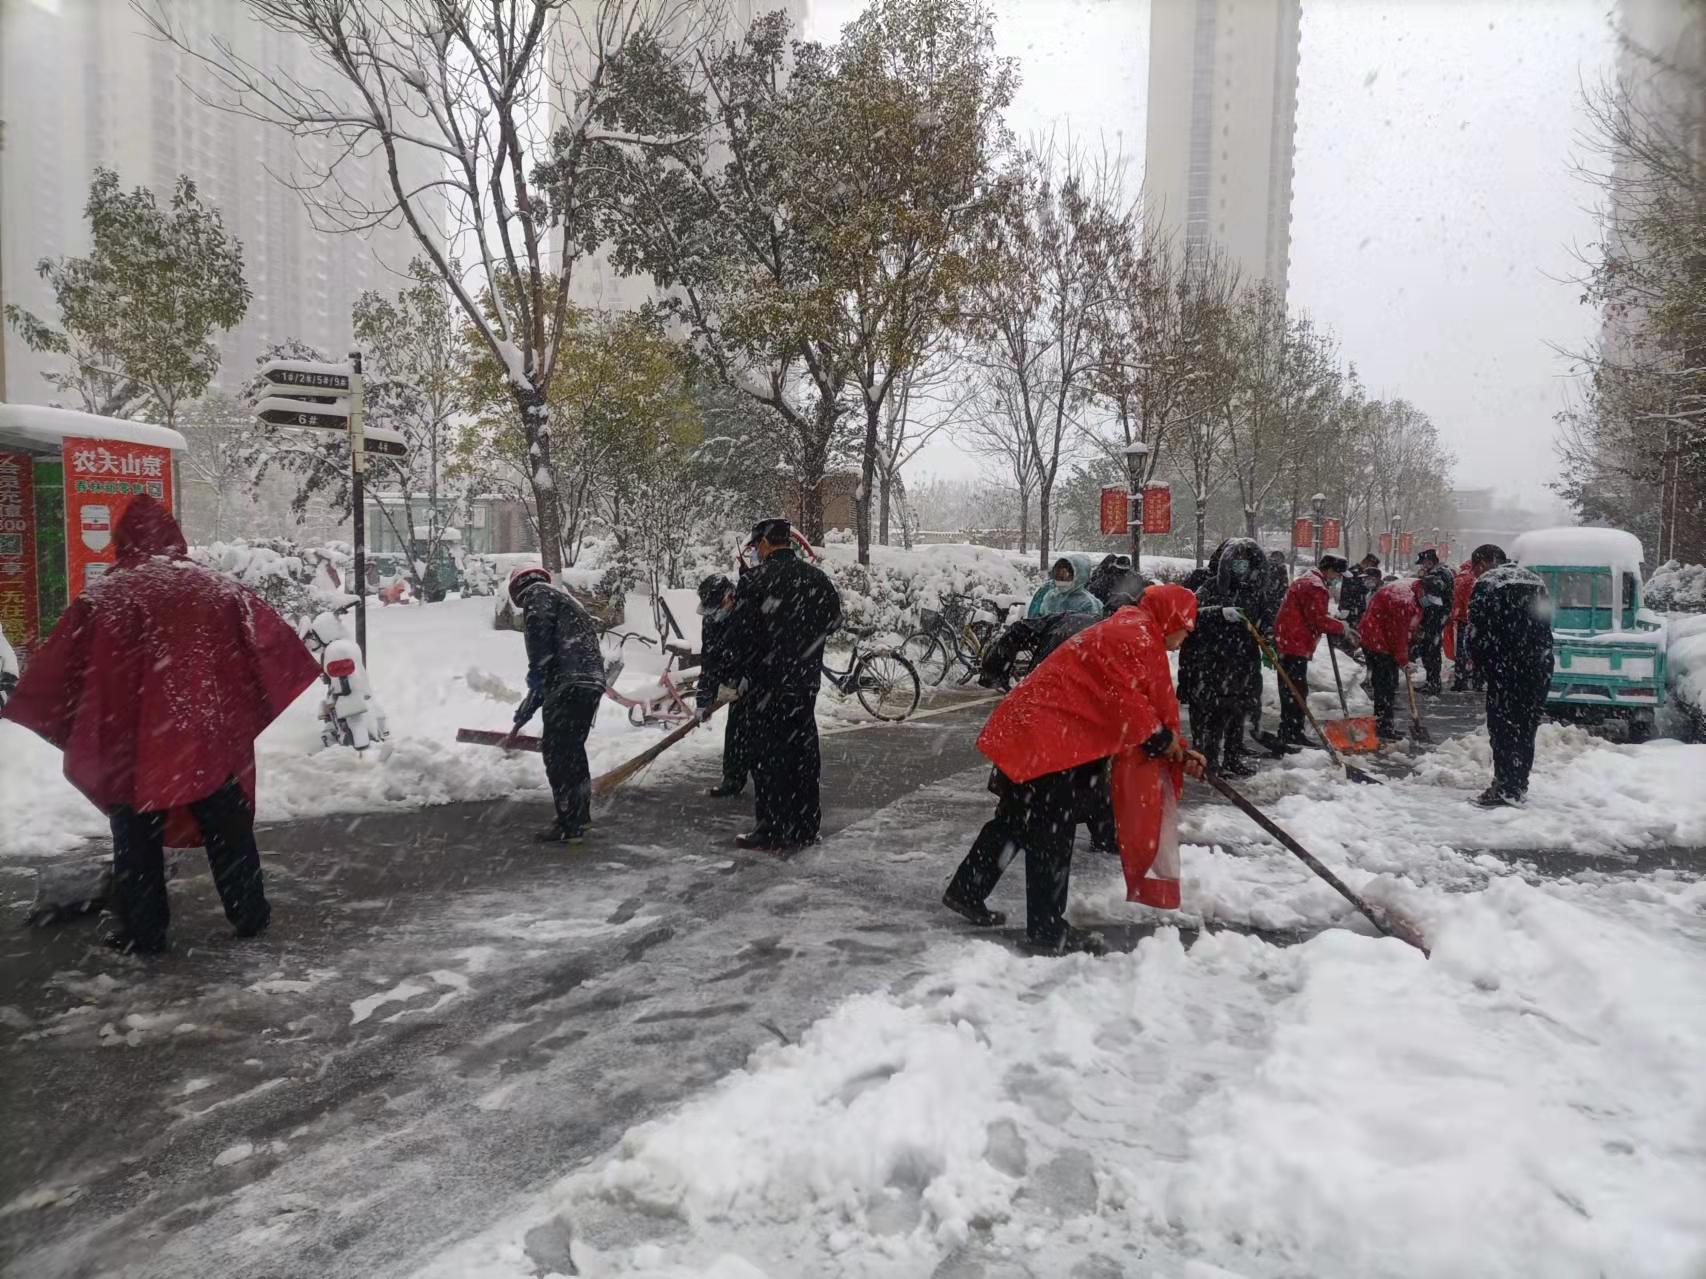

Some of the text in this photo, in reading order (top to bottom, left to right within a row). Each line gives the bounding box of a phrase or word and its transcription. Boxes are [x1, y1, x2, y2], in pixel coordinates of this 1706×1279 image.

[298, 414, 317, 425] 6#
[73, 447, 163, 477] 农夫山泉
